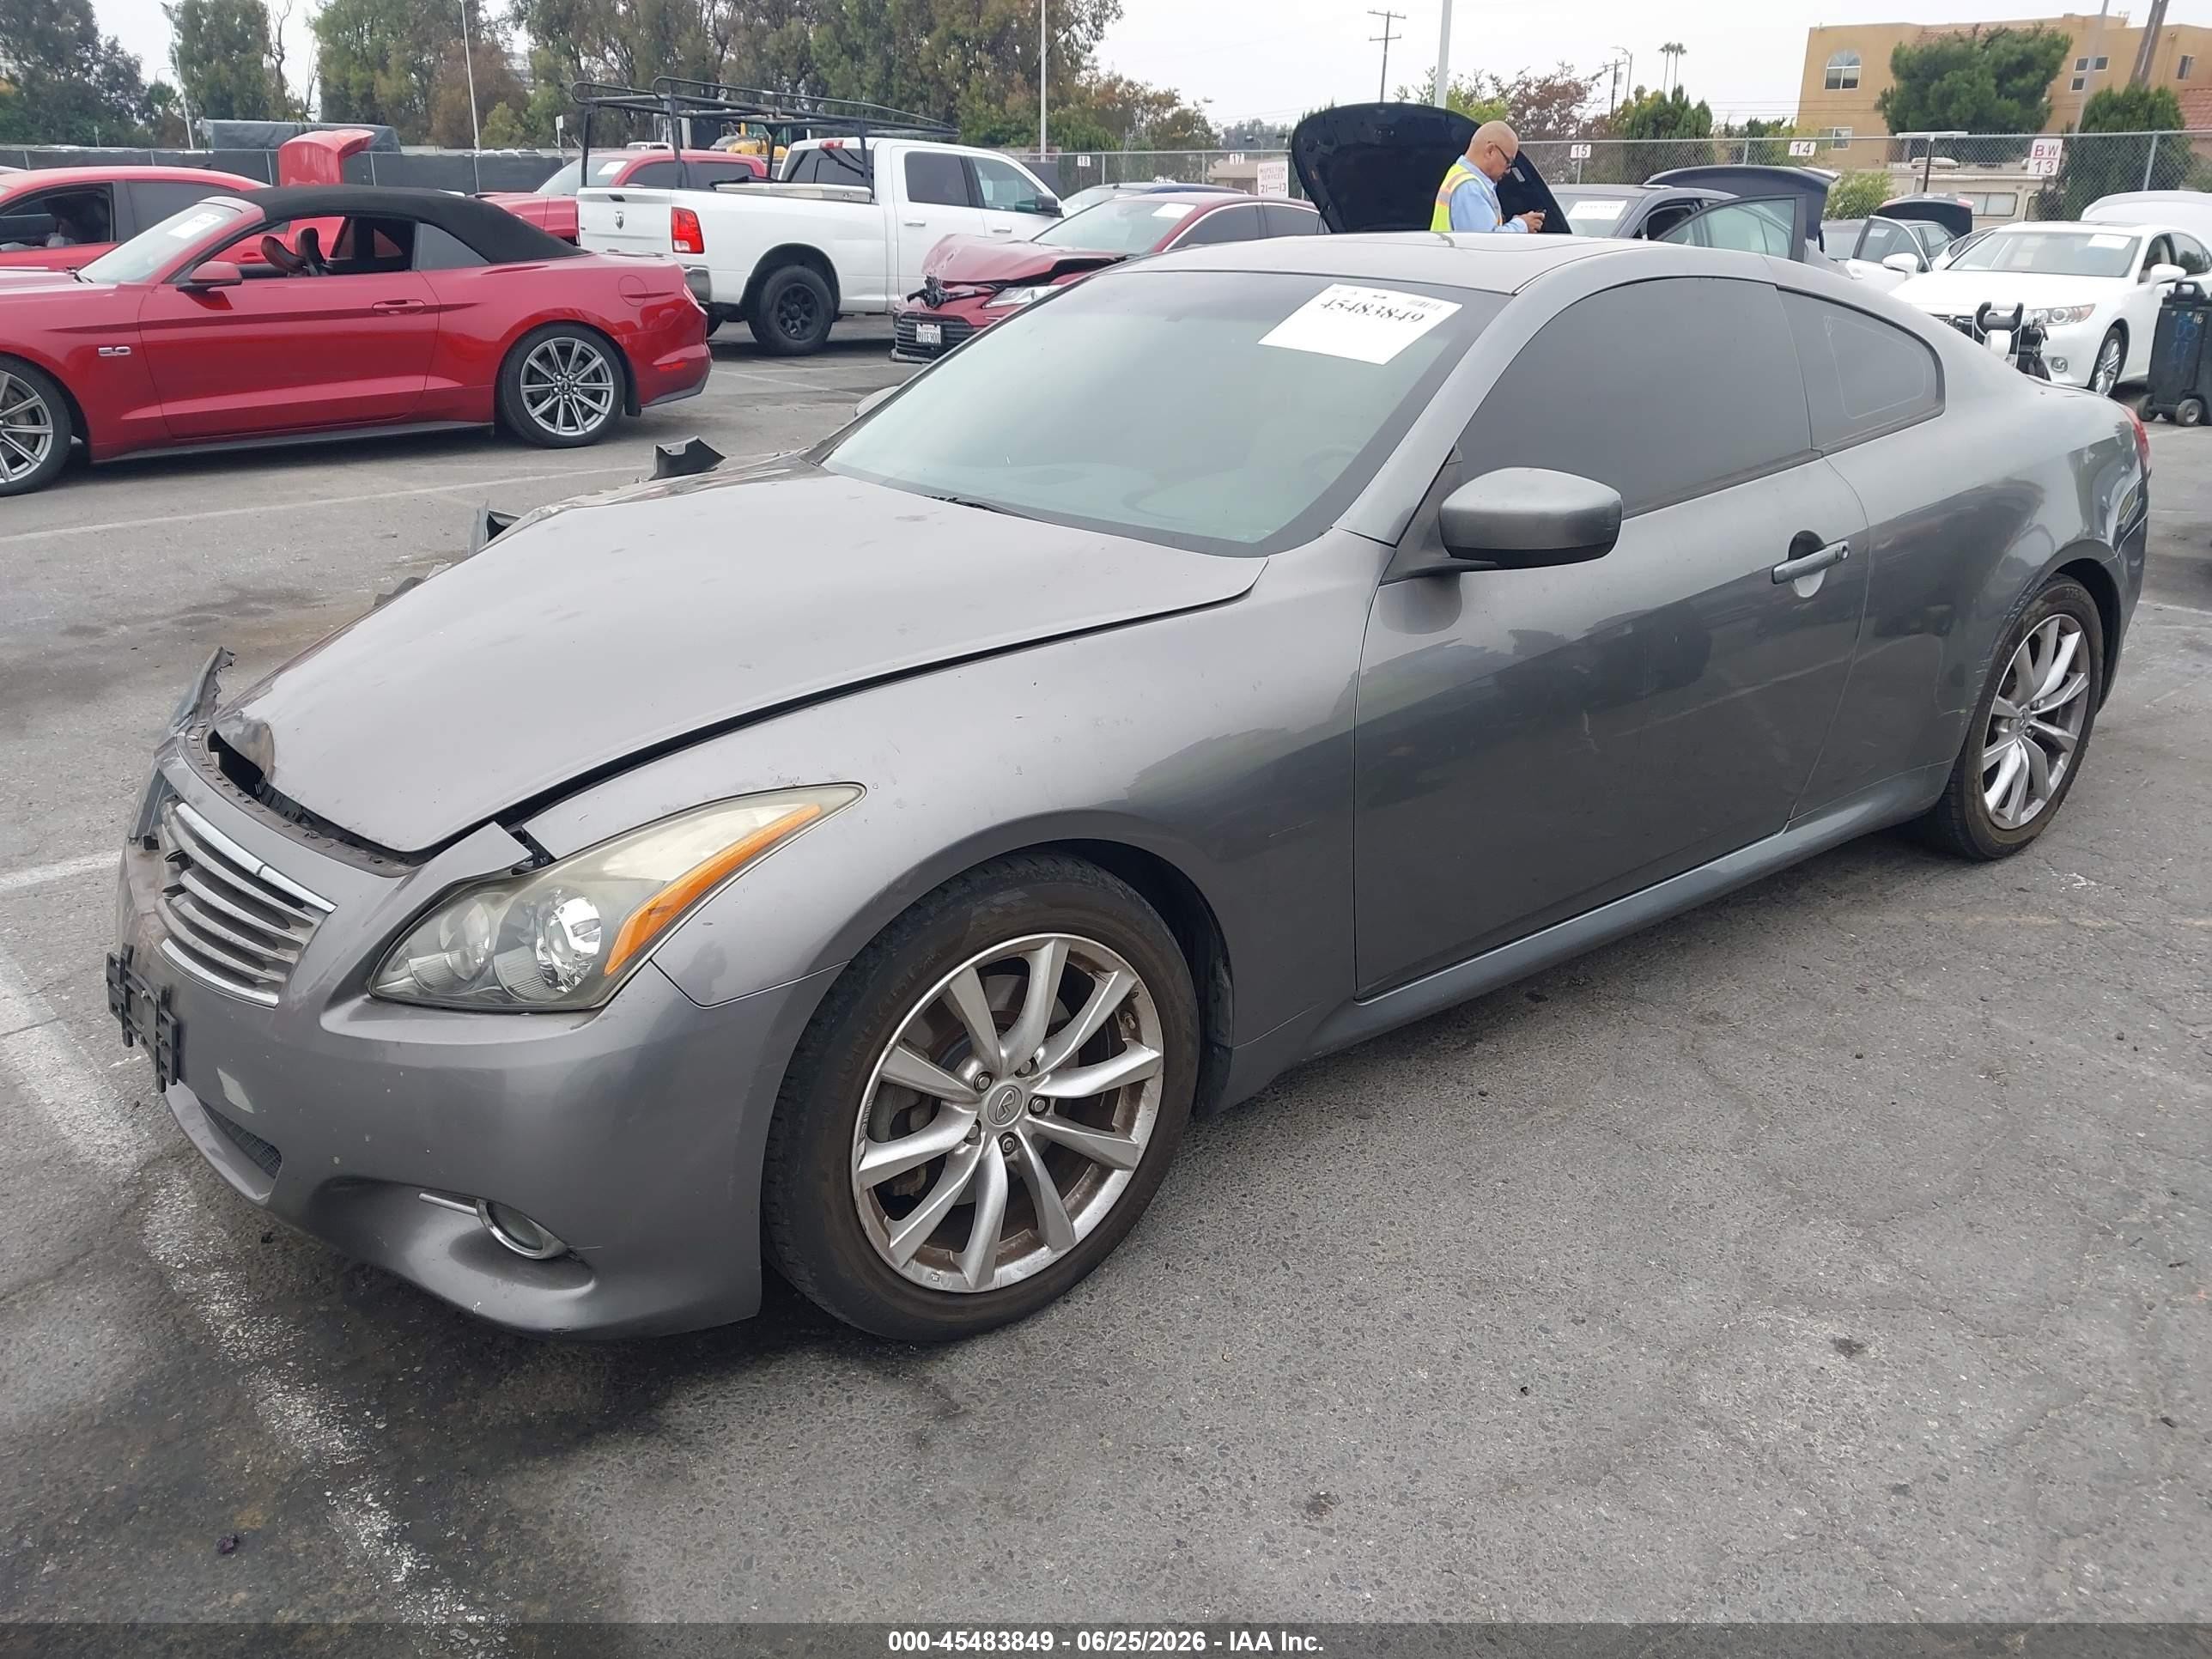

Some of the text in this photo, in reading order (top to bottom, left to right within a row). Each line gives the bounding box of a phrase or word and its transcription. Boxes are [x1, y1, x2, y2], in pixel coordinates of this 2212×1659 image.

[1575, 144, 1587, 157] 15
[1795, 143, 1810, 155] 14
[1079, 156, 1088, 166] 18
[1232, 154, 1242, 165] 17
[2035, 160, 2053, 173] 13
